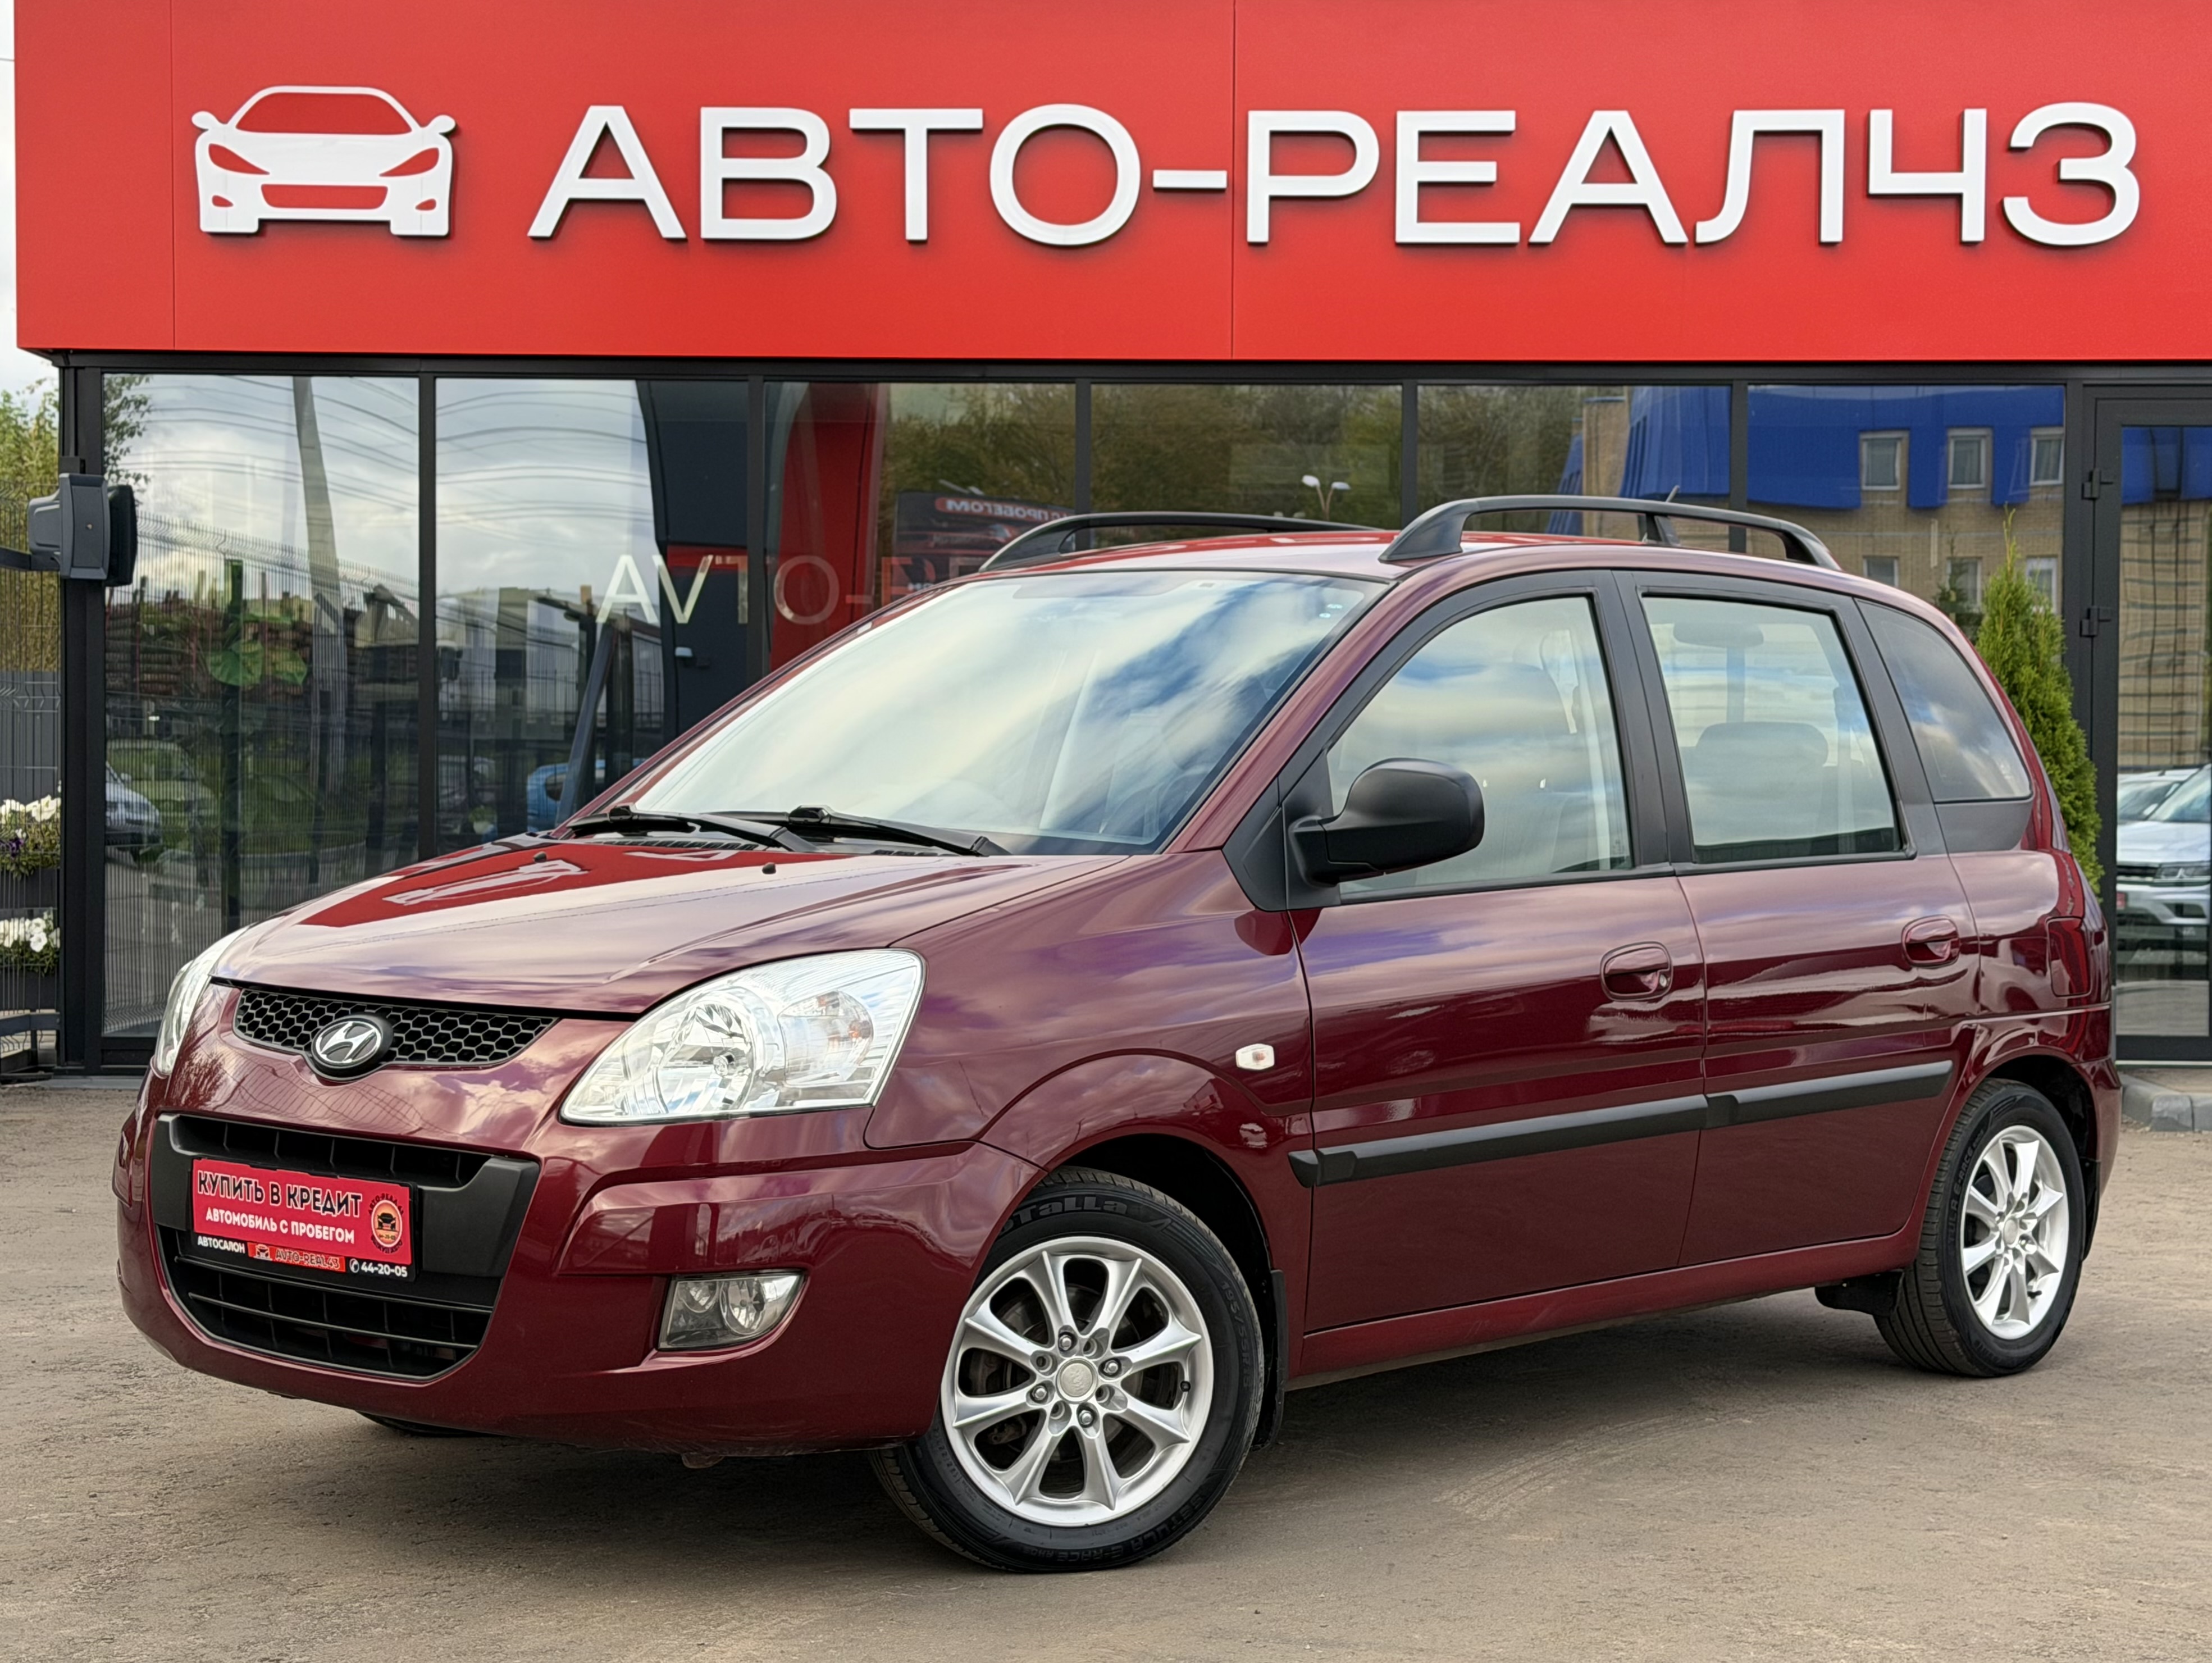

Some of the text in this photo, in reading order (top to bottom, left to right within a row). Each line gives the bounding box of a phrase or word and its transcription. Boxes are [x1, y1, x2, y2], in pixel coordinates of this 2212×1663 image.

[197, 1170, 362, 1218] КУПИТЬ В КРЕДИТ
[206, 1208, 355, 1244] АВТОМОБИЛЬ С ПРОБЕГОМ
[197, 1235, 245, 1254] АВТОСАЛОН
[275, 1248, 340, 1269] AVTO-REAL43
[361, 1263, 408, 1278] 44-20-05
